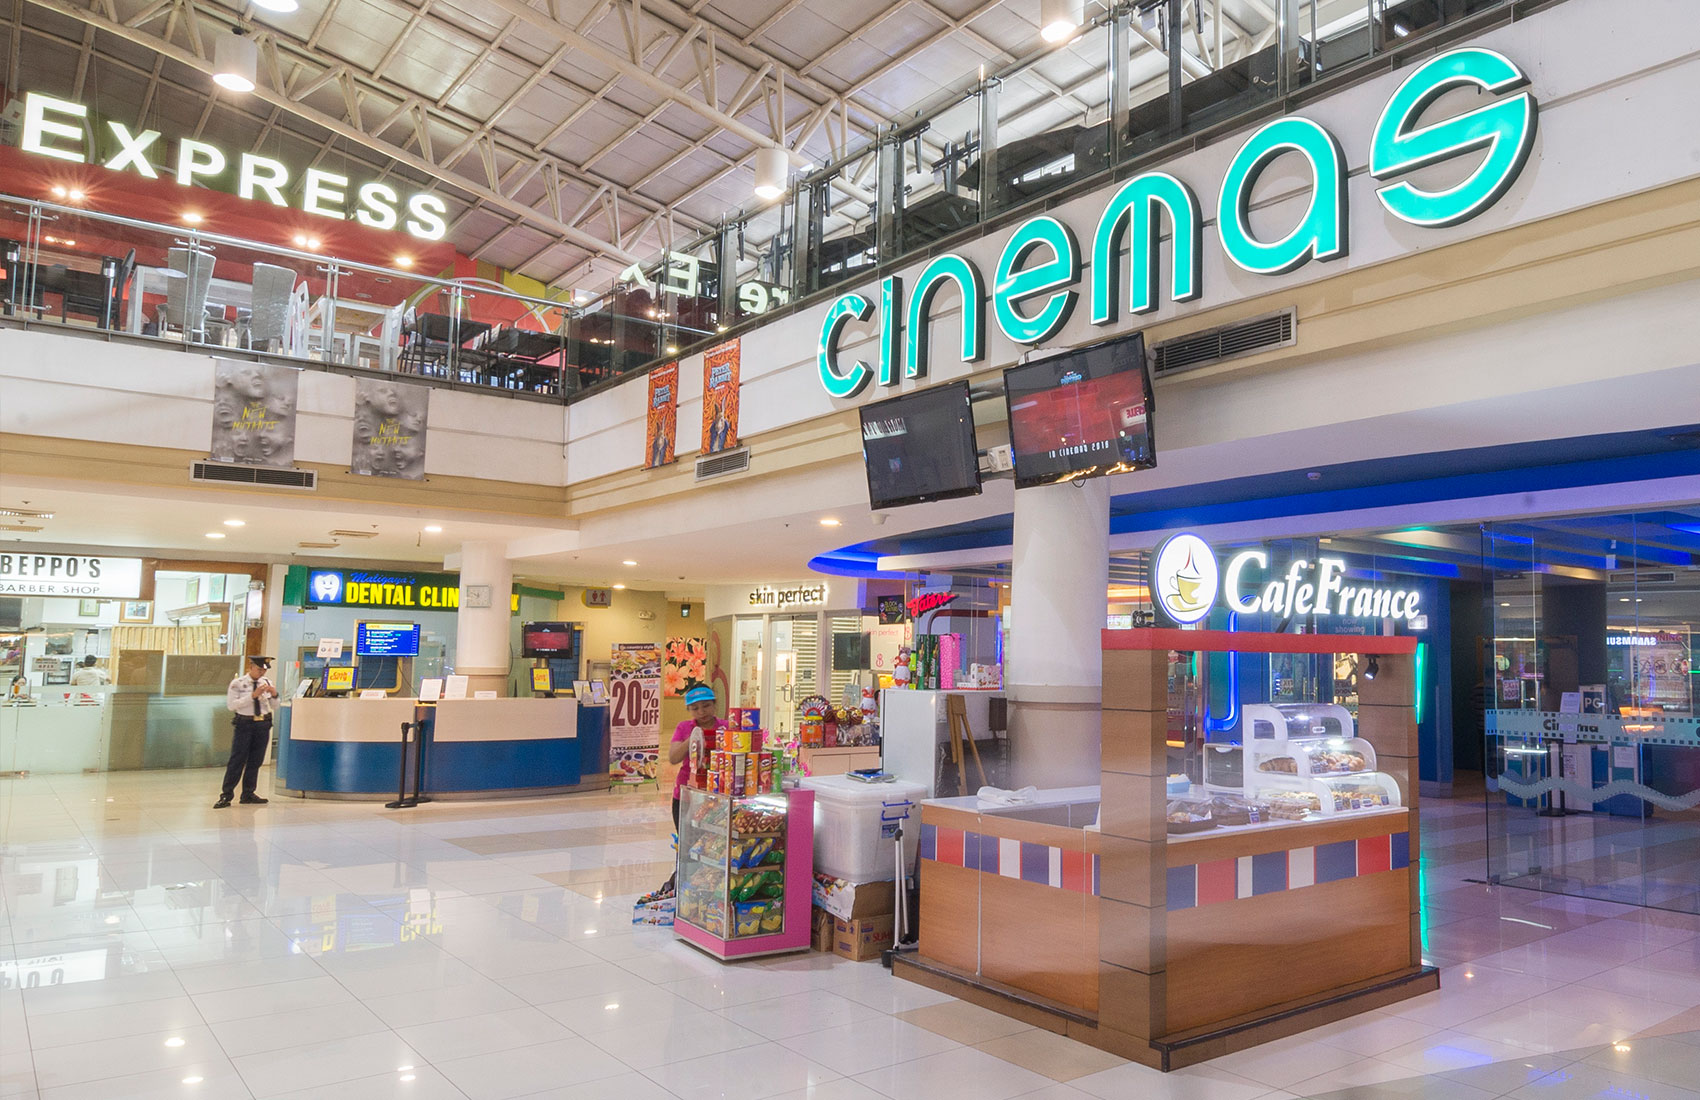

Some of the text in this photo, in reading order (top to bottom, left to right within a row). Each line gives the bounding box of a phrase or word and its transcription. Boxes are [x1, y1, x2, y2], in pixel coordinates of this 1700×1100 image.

[20, 91, 448, 241] EXPRESS
[816, 46, 1537, 398] cinemas
[242, 406, 267, 420] NEW
[232, 421, 280, 432] MUTANTS
[0, 554, 101, 578] BEPPO'S
[0, 583, 100, 594] BARBER SHOP
[346, 582, 415, 606] DENTAL
[749, 584, 826, 608] skin perfect
[1335, 625, 1366, 635] showing
[1584, 698, 1601, 709] PG
[642, 709, 659, 726] OFF
[1543, 719, 1599, 733] Cima
